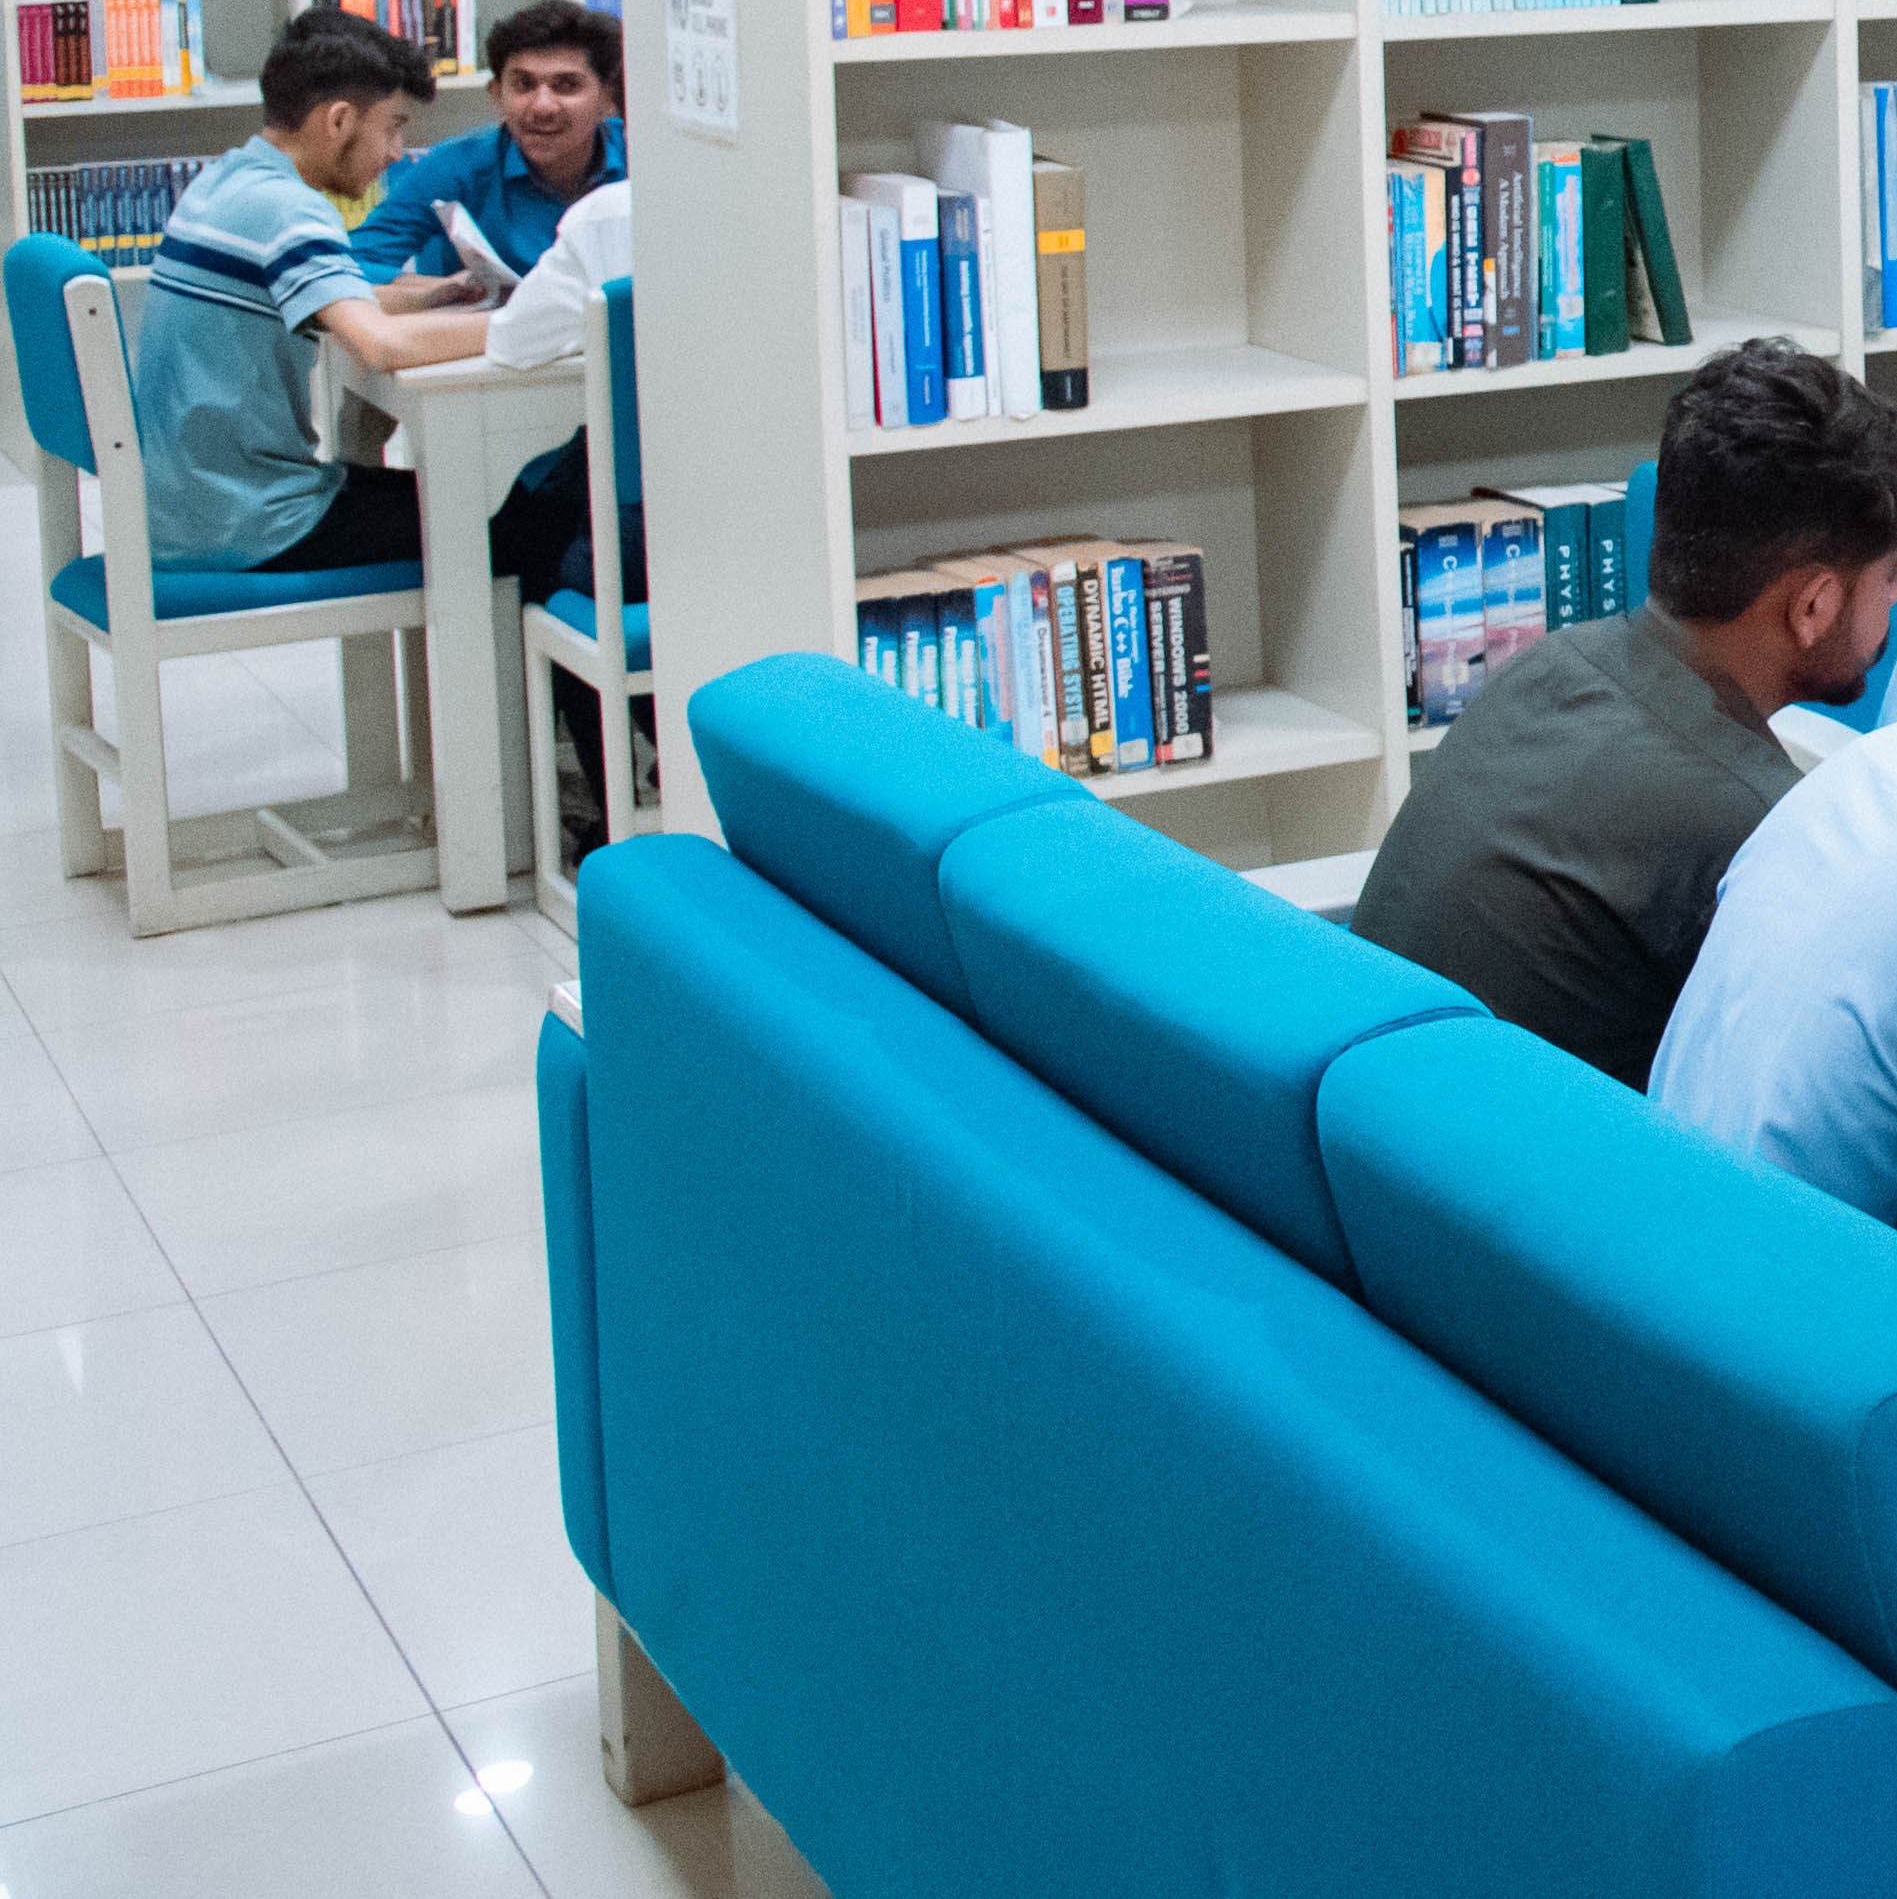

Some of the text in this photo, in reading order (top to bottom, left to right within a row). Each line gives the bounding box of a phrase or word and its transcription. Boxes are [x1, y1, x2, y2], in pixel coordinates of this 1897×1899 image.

[1057, 586, 1080, 671] OPERATING
[1110, 566, 1130, 614] Turbo
[1084, 580, 1108, 728] DYNAMIC HTML
[1150, 600, 1166, 673] SERVER
[1168, 597, 1189, 734] WINDOWS 2000
[1116, 657, 1132, 698] Bible
